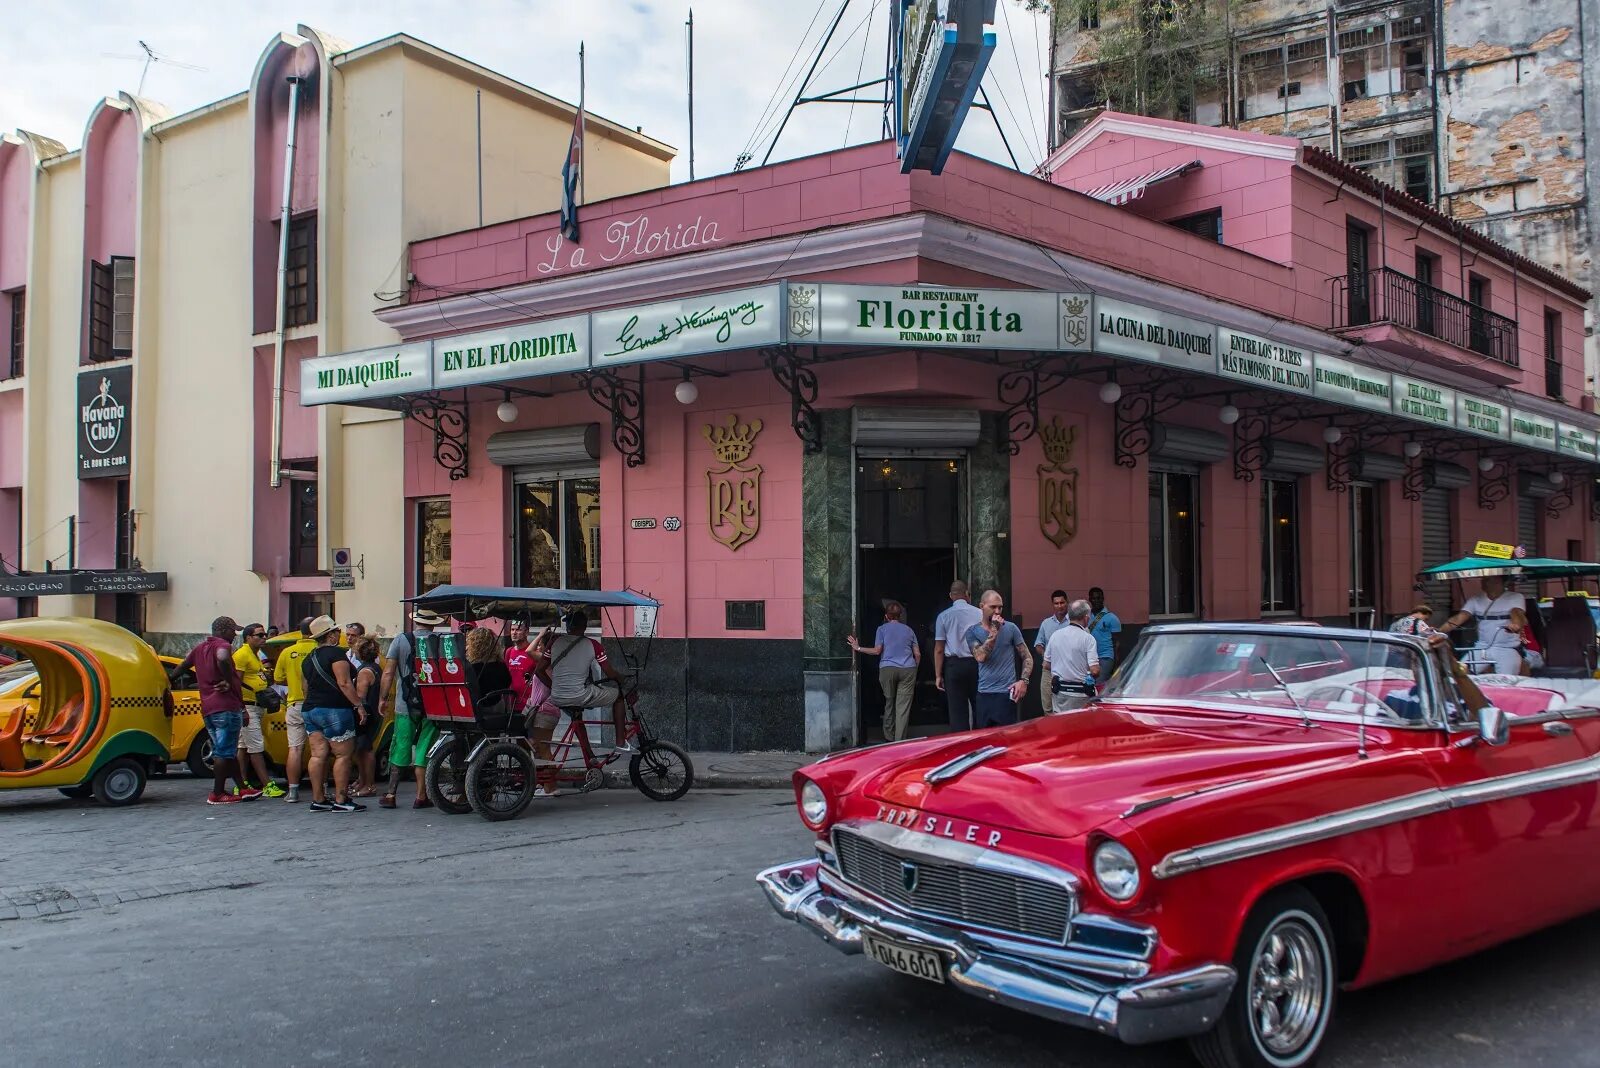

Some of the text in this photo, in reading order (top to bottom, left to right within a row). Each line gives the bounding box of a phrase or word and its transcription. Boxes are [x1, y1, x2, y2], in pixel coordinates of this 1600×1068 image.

[537, 213, 725, 273] La Florida
[902, 290, 979, 302] BAR RESTAURANT
[604, 300, 763, 356] Ernest Hemingway
[857, 299, 1023, 332] Floridita
[899, 331, 981, 343] FUNDADO EN 1817
[1100, 313, 1212, 355] LA CUNA DEL DAIQUIRÍ
[1230, 334, 1302, 366] ENTRE LOS 7 BARES
[443, 332, 577, 371] EN EL FLORIDITA
[317, 353, 412, 388] MI DAIQUIRÍ...
[1222, 351, 1310, 389] MÁS FAMOSOS DEL MUNDO
[1316, 367, 1324, 382] EL
[1324, 369, 1351, 390] FAVORITO
[1351, 376, 1359, 391] DE
[1408, 383, 1419, 398] THE
[82, 405, 125, 423] Havana
[91, 421, 116, 441] Club
[83, 455, 127, 468] EL RON DE CUBA
[27, 582, 63, 591] CUBANO
[876, 806, 1002, 847] CHRYSLER
